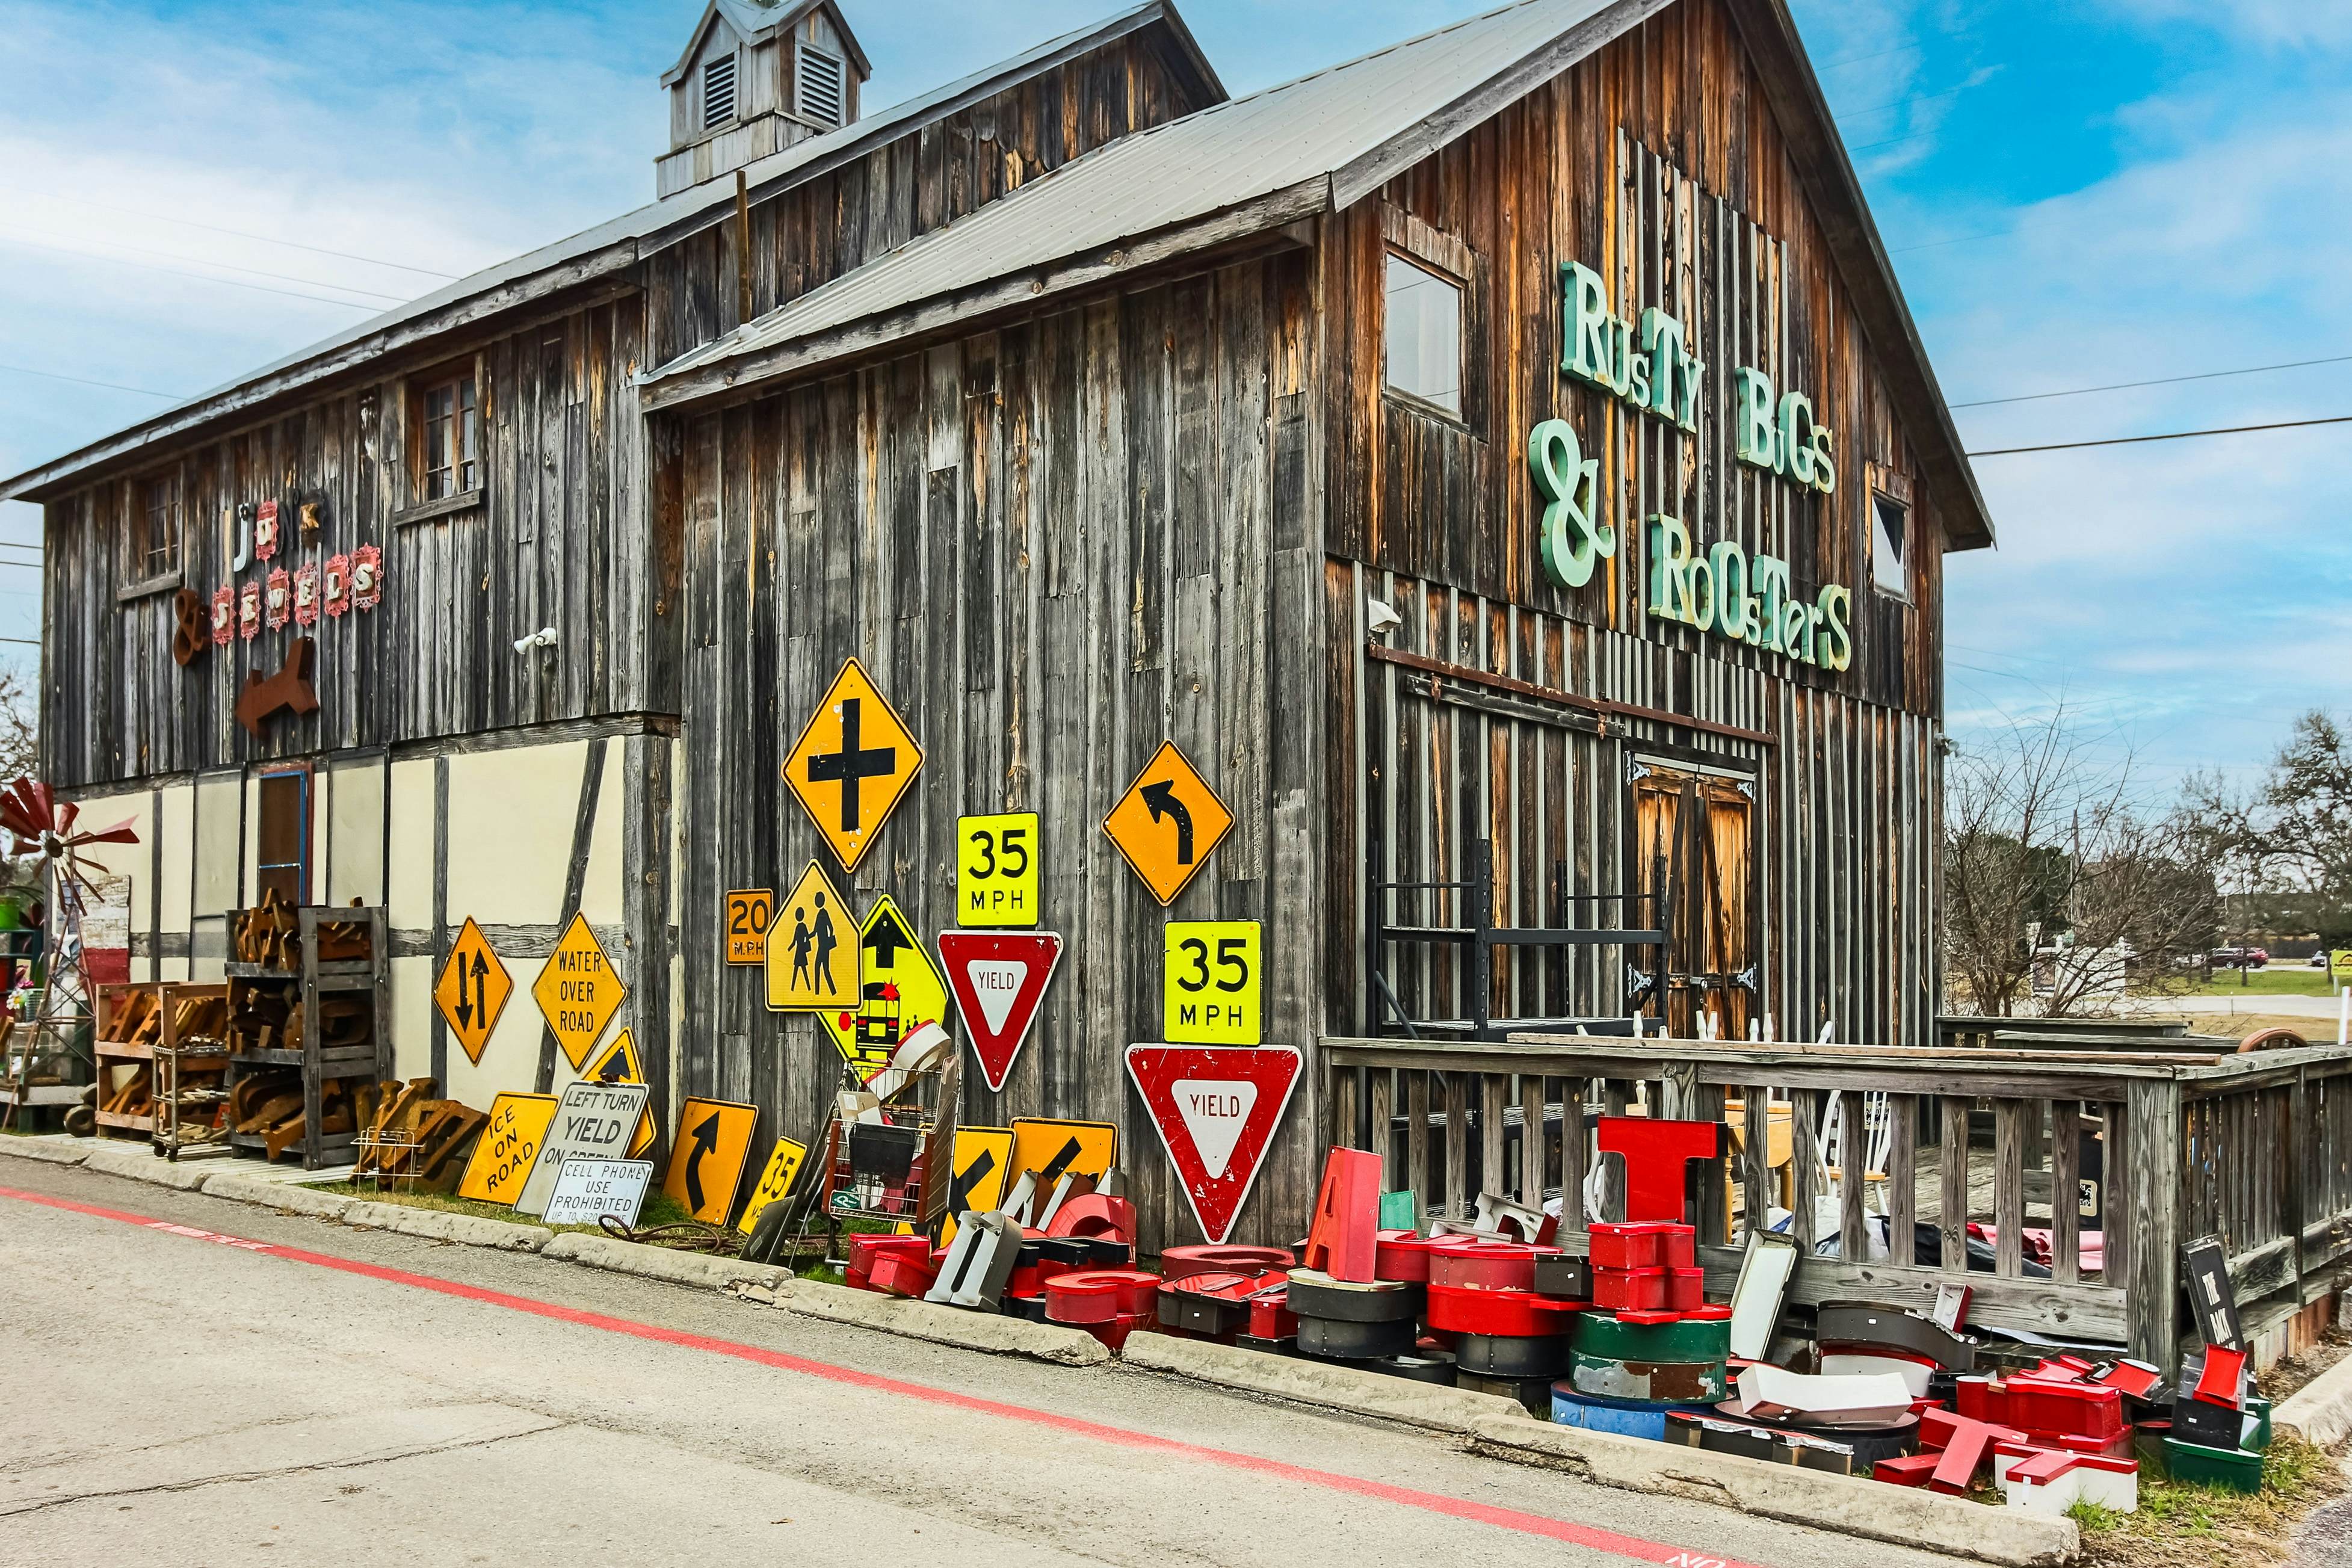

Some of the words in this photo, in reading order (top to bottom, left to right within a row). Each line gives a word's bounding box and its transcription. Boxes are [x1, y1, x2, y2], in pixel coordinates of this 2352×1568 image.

[1529, 419, 1616, 587] &
[968, 829, 1028, 879] 35
[971, 890, 1023, 910] MPH
[731, 899, 769, 934] 20
[558, 951, 601, 972] WATER
[1177, 938, 1249, 992] 35
[560, 980, 594, 1002] OVER
[978, 971, 1014, 990] YIELD
[560, 1010, 594, 1032] ROAD
[1180, 1004, 1242, 1026] MPH
[565, 1090, 601, 1108] LEFT
[602, 1093, 640, 1112] TURN
[1190, 1094, 1241, 1117] YIELD
[489, 1105, 516, 1139] ICE
[564, 1116, 622, 1144] YIELD
[495, 1128, 517, 1159] ON
[545, 1147, 566, 1165] ON
[487, 1142, 534, 1194] ROAD
[565, 1164, 593, 1178] CELL
[602, 1165, 642, 1180] PHONE
[762, 1152, 796, 1200] 35
[585, 1181, 611, 1194] USE
[554, 1196, 632, 1212] PROHIBITED
[551, 1211, 562, 1220] UP
[567, 1212, 577, 1221] TO
